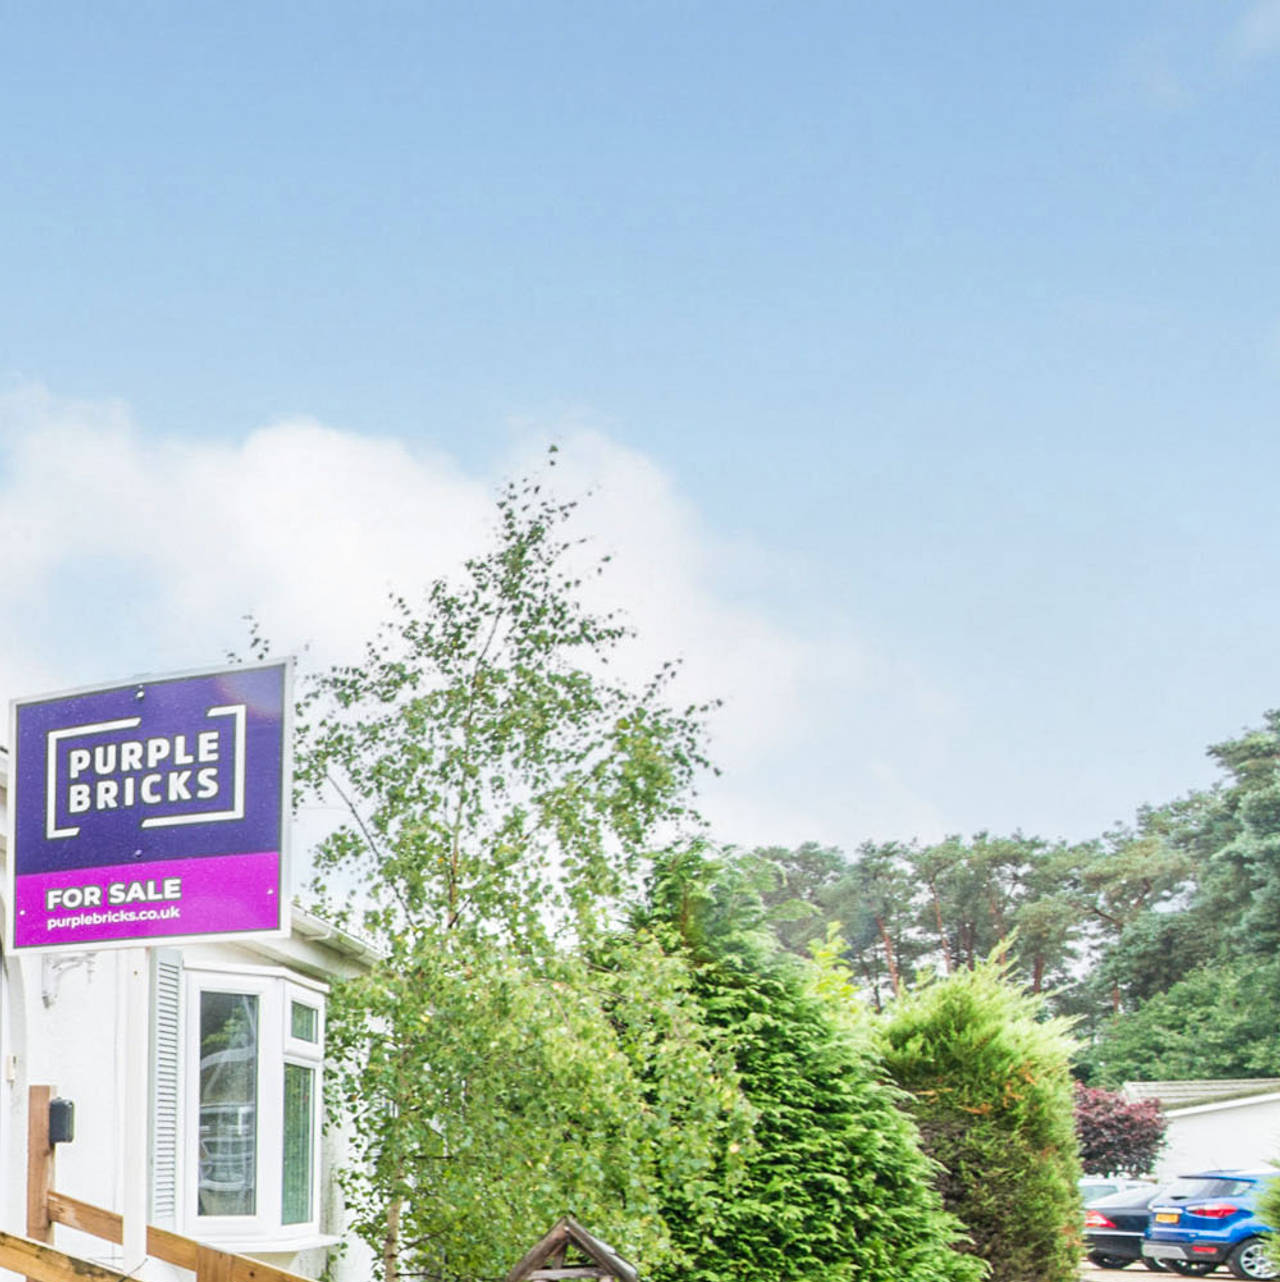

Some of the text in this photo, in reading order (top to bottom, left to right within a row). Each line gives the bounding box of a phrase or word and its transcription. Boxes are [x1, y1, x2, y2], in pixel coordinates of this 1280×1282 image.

[69, 731, 219, 779] PURPLE
[69, 767, 219, 813] BRICKS
[46, 878, 182, 910] FOR SALE
[46, 906, 181, 930] purplebricks.co.uk
